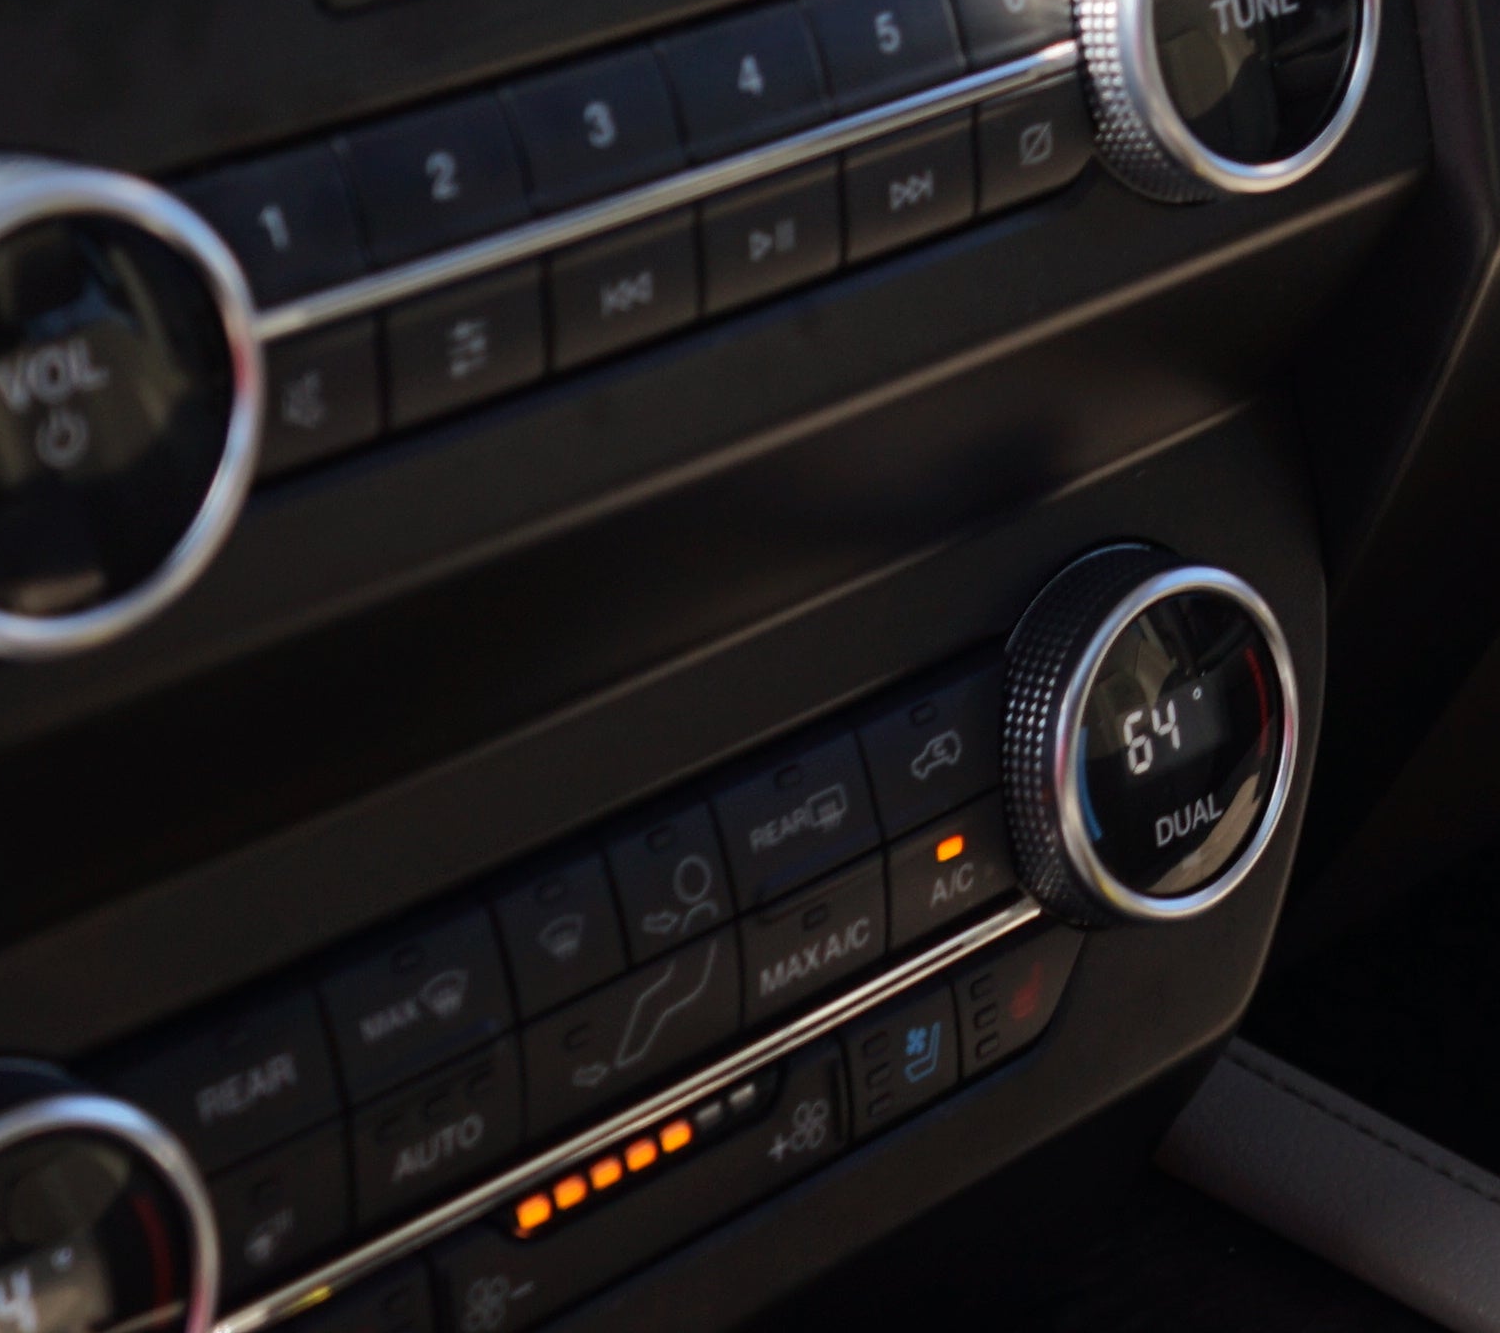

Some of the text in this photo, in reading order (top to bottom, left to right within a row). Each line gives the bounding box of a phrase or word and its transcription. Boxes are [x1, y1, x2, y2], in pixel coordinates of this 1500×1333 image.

[873, 12, 900, 54] 5
[736, 54, 765, 97] 4
[582, 100, 617, 149] 3
[424, 150, 458, 203] 2
[259, 204, 289, 252] 1
[1154, 792, 1224, 849] DUAL
[929, 863, 976, 908] A/C
[758, 916, 873, 997] MAX A/C
[198, 1052, 297, 1125] REAR
[392, 1114, 486, 1183] AUTO
